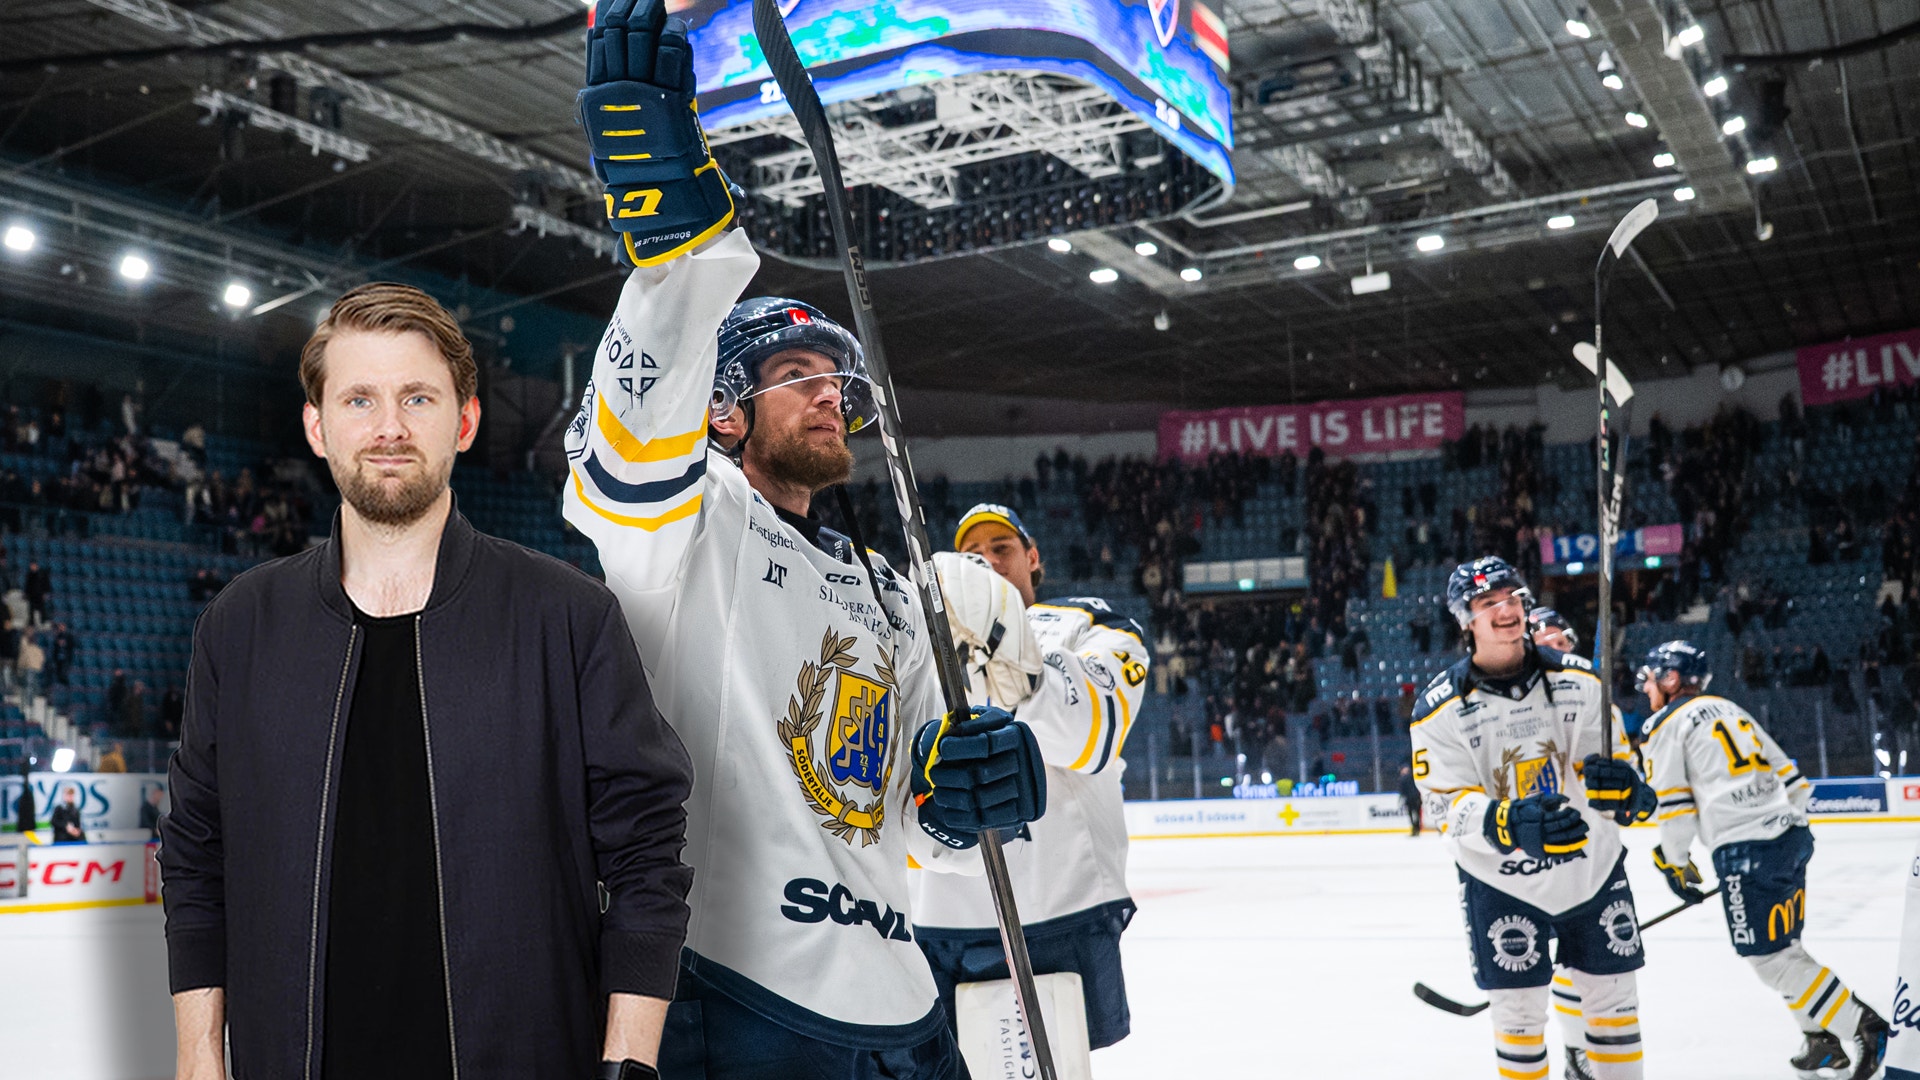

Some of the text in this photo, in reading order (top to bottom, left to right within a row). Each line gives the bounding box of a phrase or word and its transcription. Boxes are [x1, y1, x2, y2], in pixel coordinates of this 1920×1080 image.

[849, 252, 871, 305] CCM
[1181, 403, 1444, 453] #LIVE IS LIFE
[762, 558, 787, 588] LT
[796, 748, 834, 808] SÖDERTÄLJE
[922, 822, 964, 847] CCM
[1725, 873, 1750, 945] Dialect
